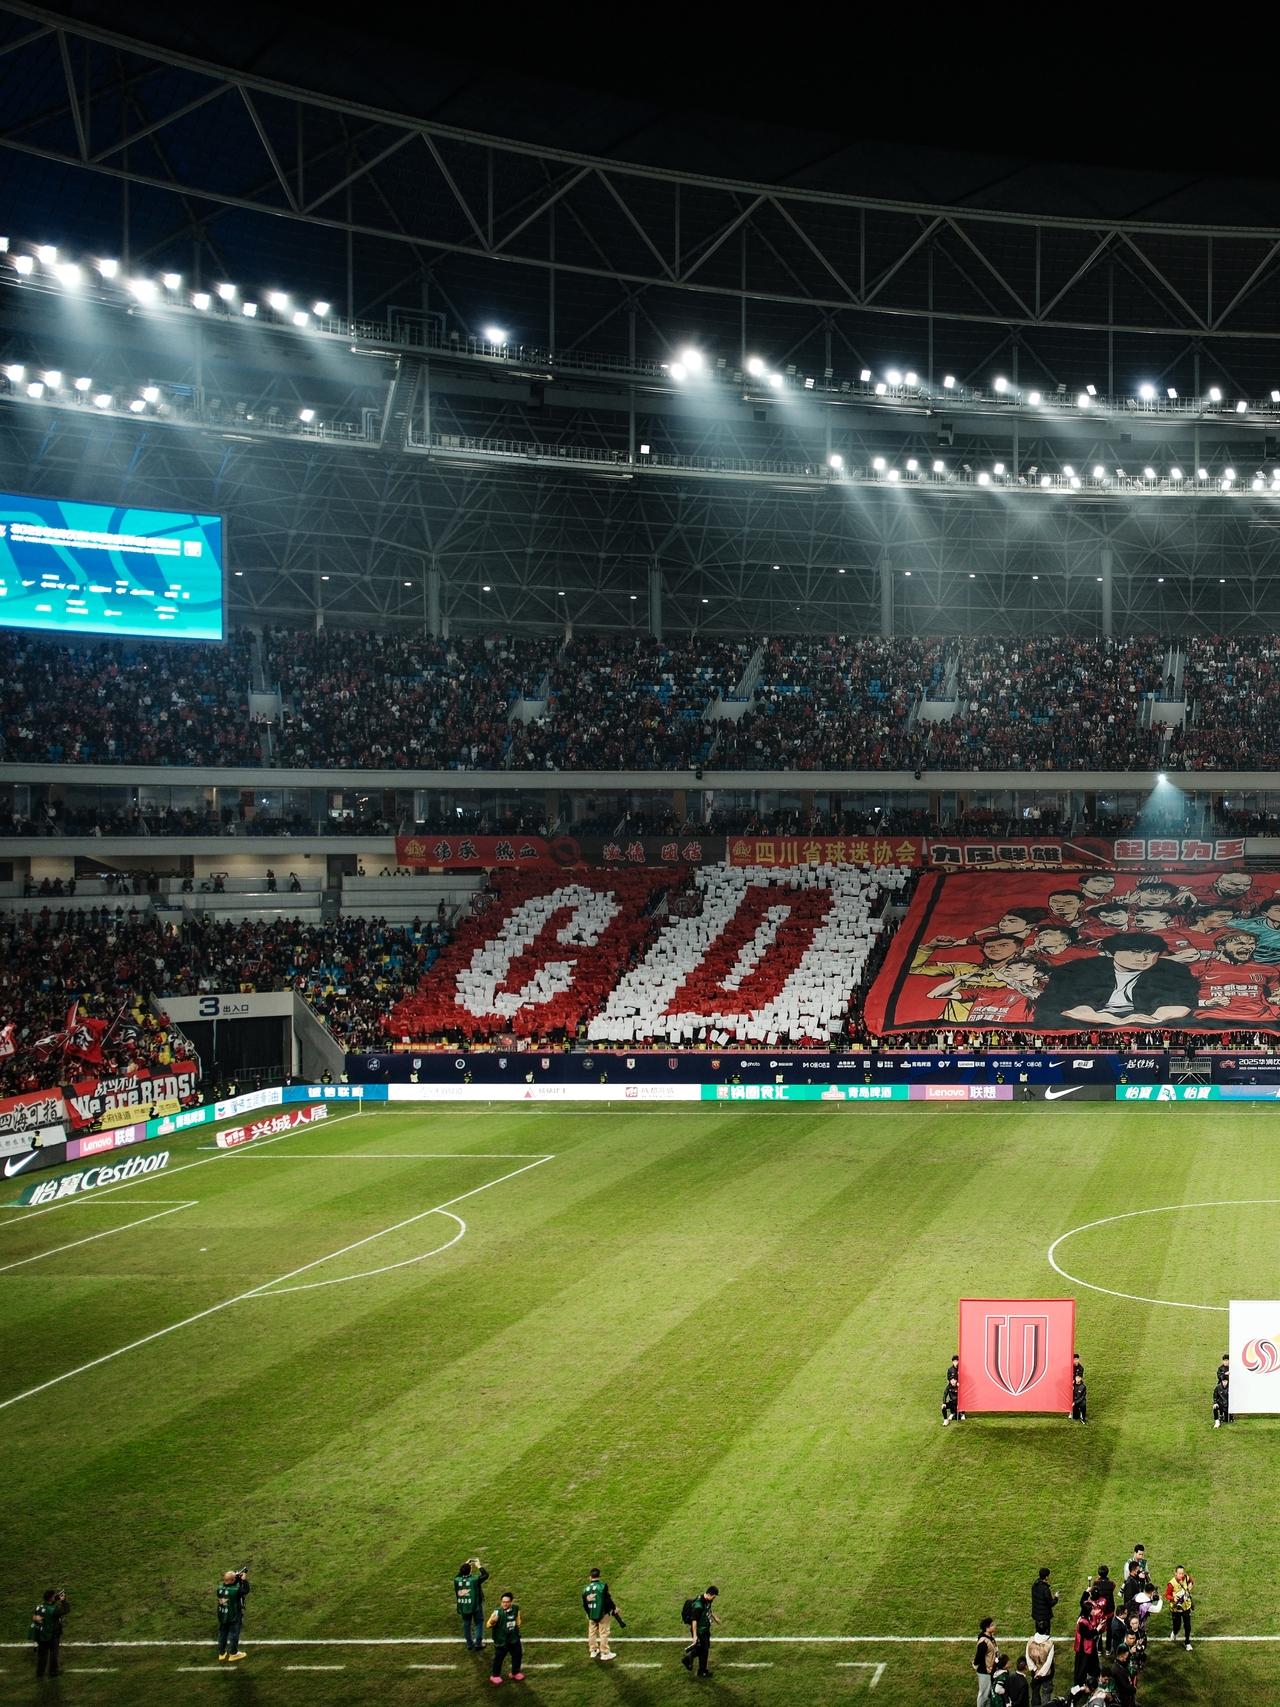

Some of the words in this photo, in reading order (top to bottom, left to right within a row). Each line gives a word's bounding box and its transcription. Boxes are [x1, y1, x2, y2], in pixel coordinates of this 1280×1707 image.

[753, 840, 917, 864] 四川省球迷协会
[199, 997, 219, 1017] 3
[223, 1004, 249, 1013] 出入口
[71, 1094, 101, 1120] We
[105, 1090, 139, 1111] are
[141, 1073, 196, 1105] REDS!
[848, 1086, 892, 1098] 青岛啤酒
[929, 1088, 966, 1097] Lenovo
[970, 1086, 997, 1099] 联想
[250, 1104, 328, 1140] 兴城人居
[83, 1137, 112, 1151] Lenovo
[81, 1150, 169, 1190] C'estbon
